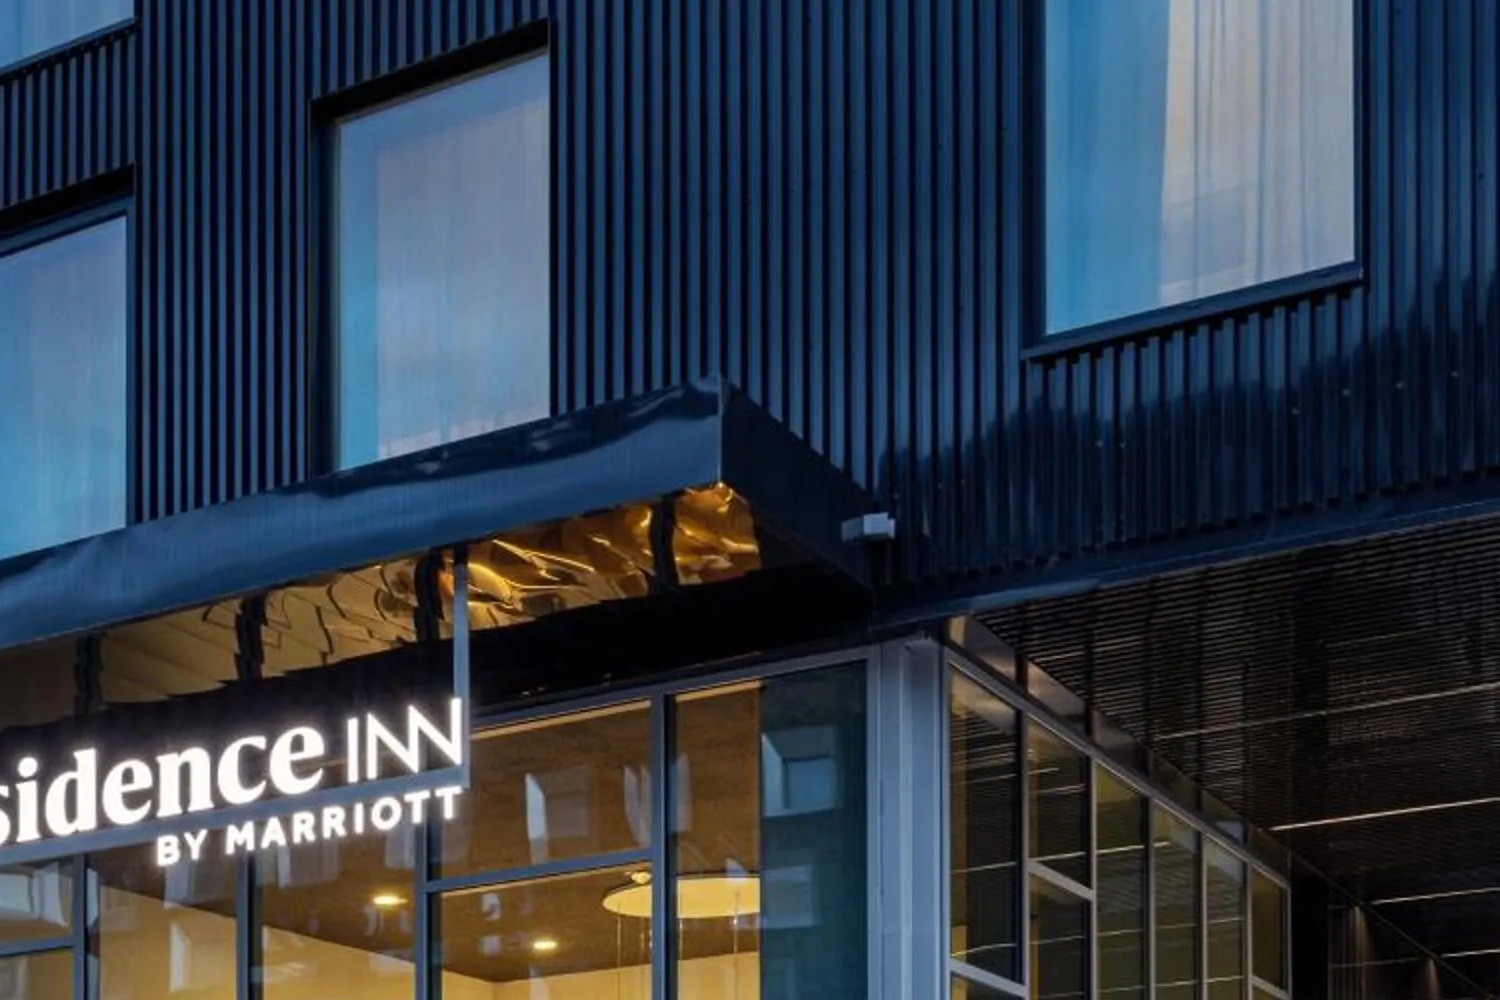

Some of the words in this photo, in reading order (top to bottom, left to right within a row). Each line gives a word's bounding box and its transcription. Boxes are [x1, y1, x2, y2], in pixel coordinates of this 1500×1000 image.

[347, 697, 462, 784] INN
[156, 828, 207, 867] BY
[225, 785, 462, 856] MARRIOTT
